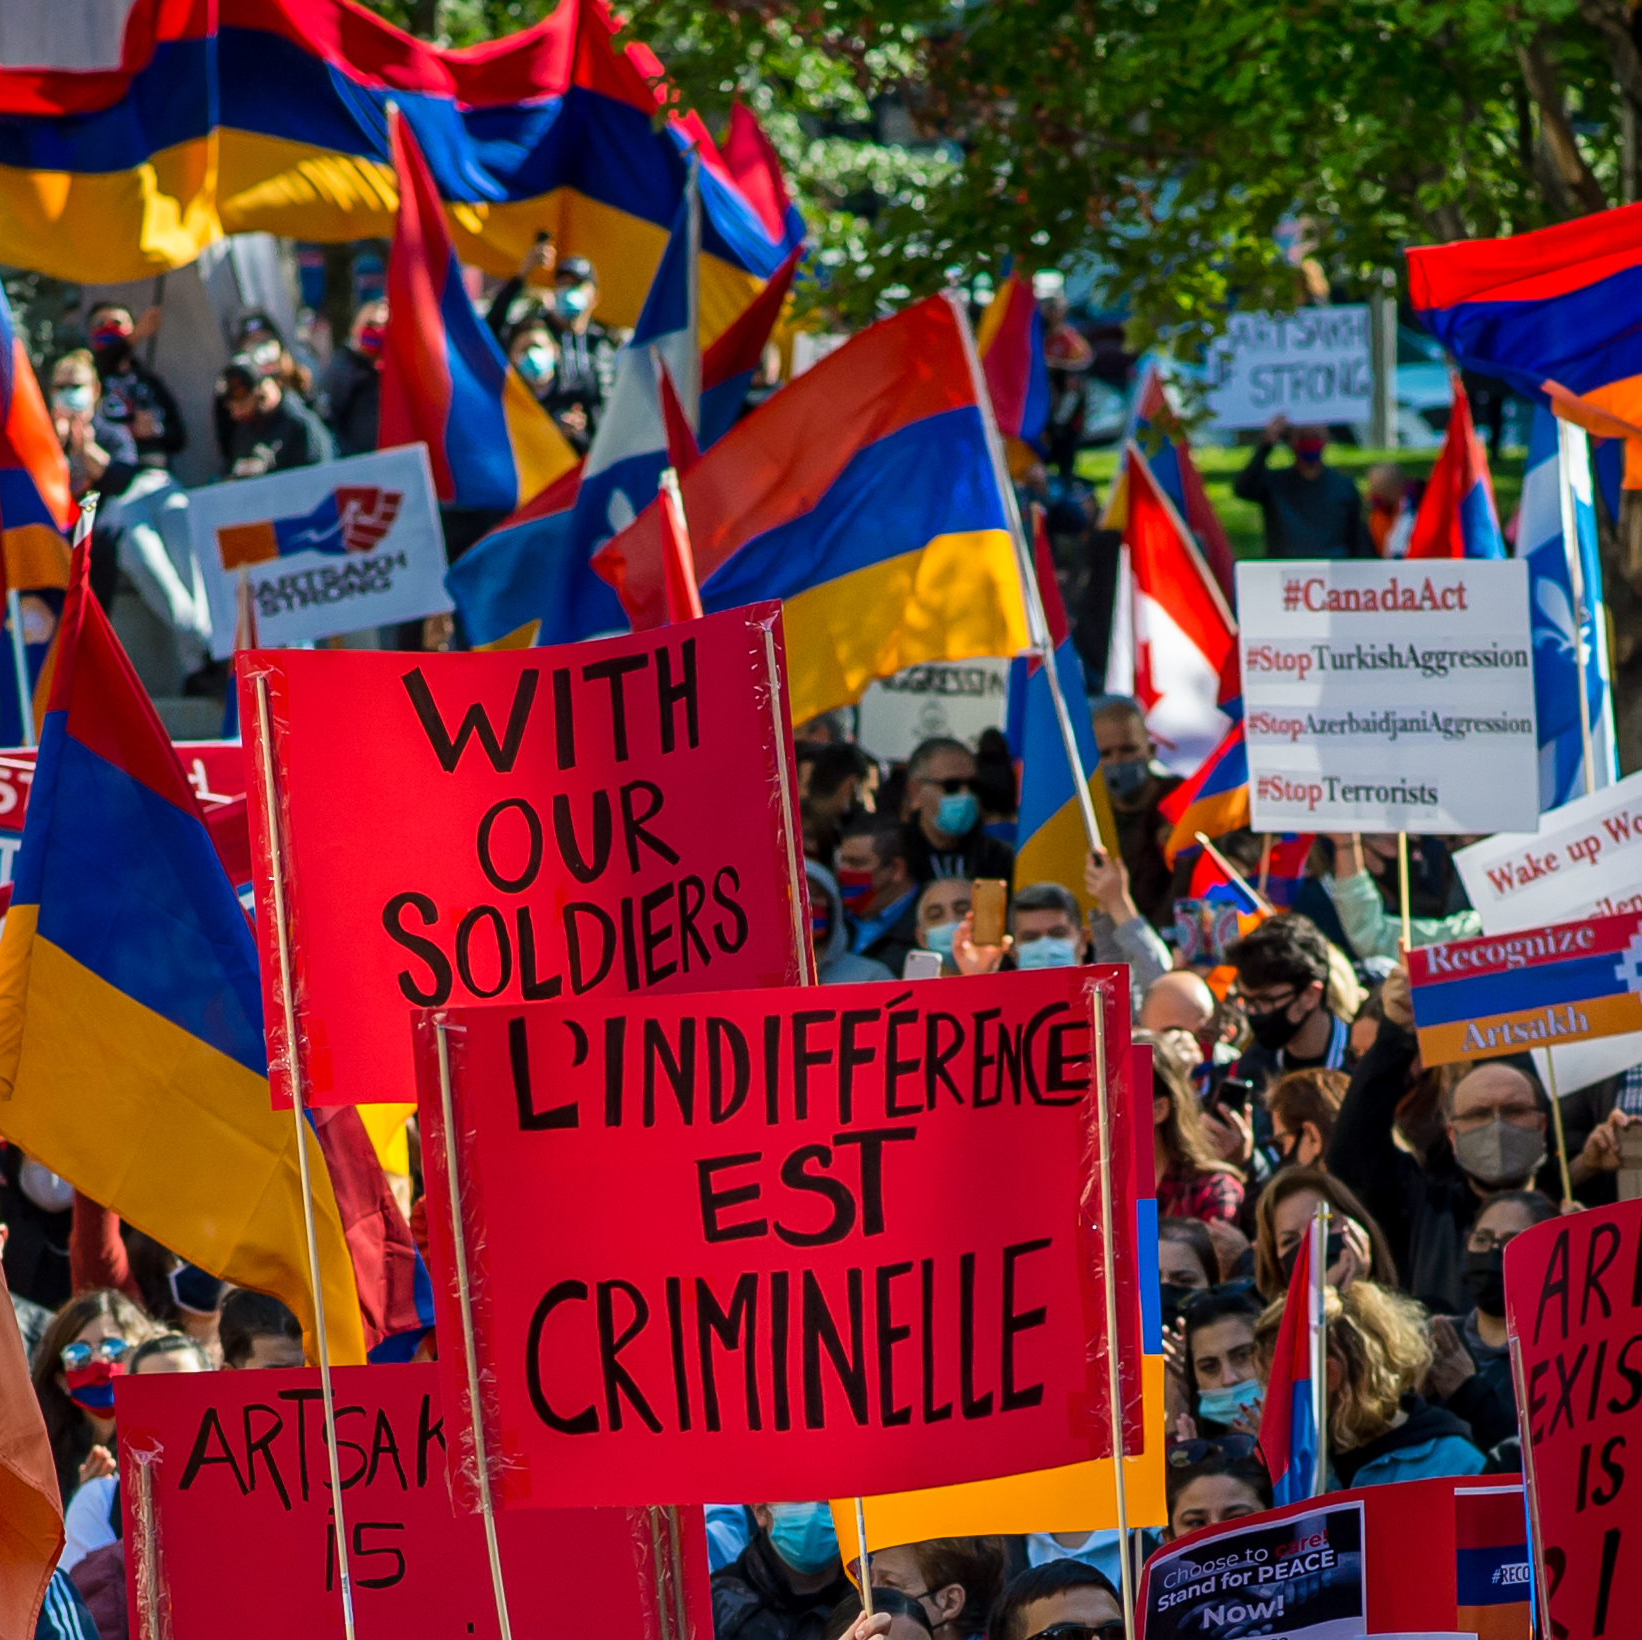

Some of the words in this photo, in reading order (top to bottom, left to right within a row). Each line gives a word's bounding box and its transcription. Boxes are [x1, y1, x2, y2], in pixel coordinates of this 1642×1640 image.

[258, 577, 393, 618] STRONG
[1283, 577, 1468, 613] #CanadaAct
[1247, 643, 1529, 679] #StopTurkishAggression
[402, 638, 700, 775] WITH
[1249, 711, 1532, 742] #StopAzerbaidjaniAggression
[1257, 776, 1438, 811] #StopTerrorists
[477, 779, 682, 895] OUR
[1487, 849, 1560, 895] Wake
[1567, 829, 1603, 867] up
[382, 865, 749, 1008] SOLDIERS
[1425, 921, 1596, 976] Recognize
[1460, 1005, 1591, 1054] Artsakh
[694, 1126, 917, 1247] EST
[525, 1237, 1054, 1437] CRIMINELLE
[1574, 1432, 1626, 1513] IS
[1157, 1577, 1215, 1613] Stand
[1221, 1571, 1252, 1590] for
[1258, 1549, 1336, 1583] PEACE
[1163, 1552, 1239, 1589] Choose
[1245, 1548, 1268, 1564] to
[1275, 1529, 1330, 1558] care!
